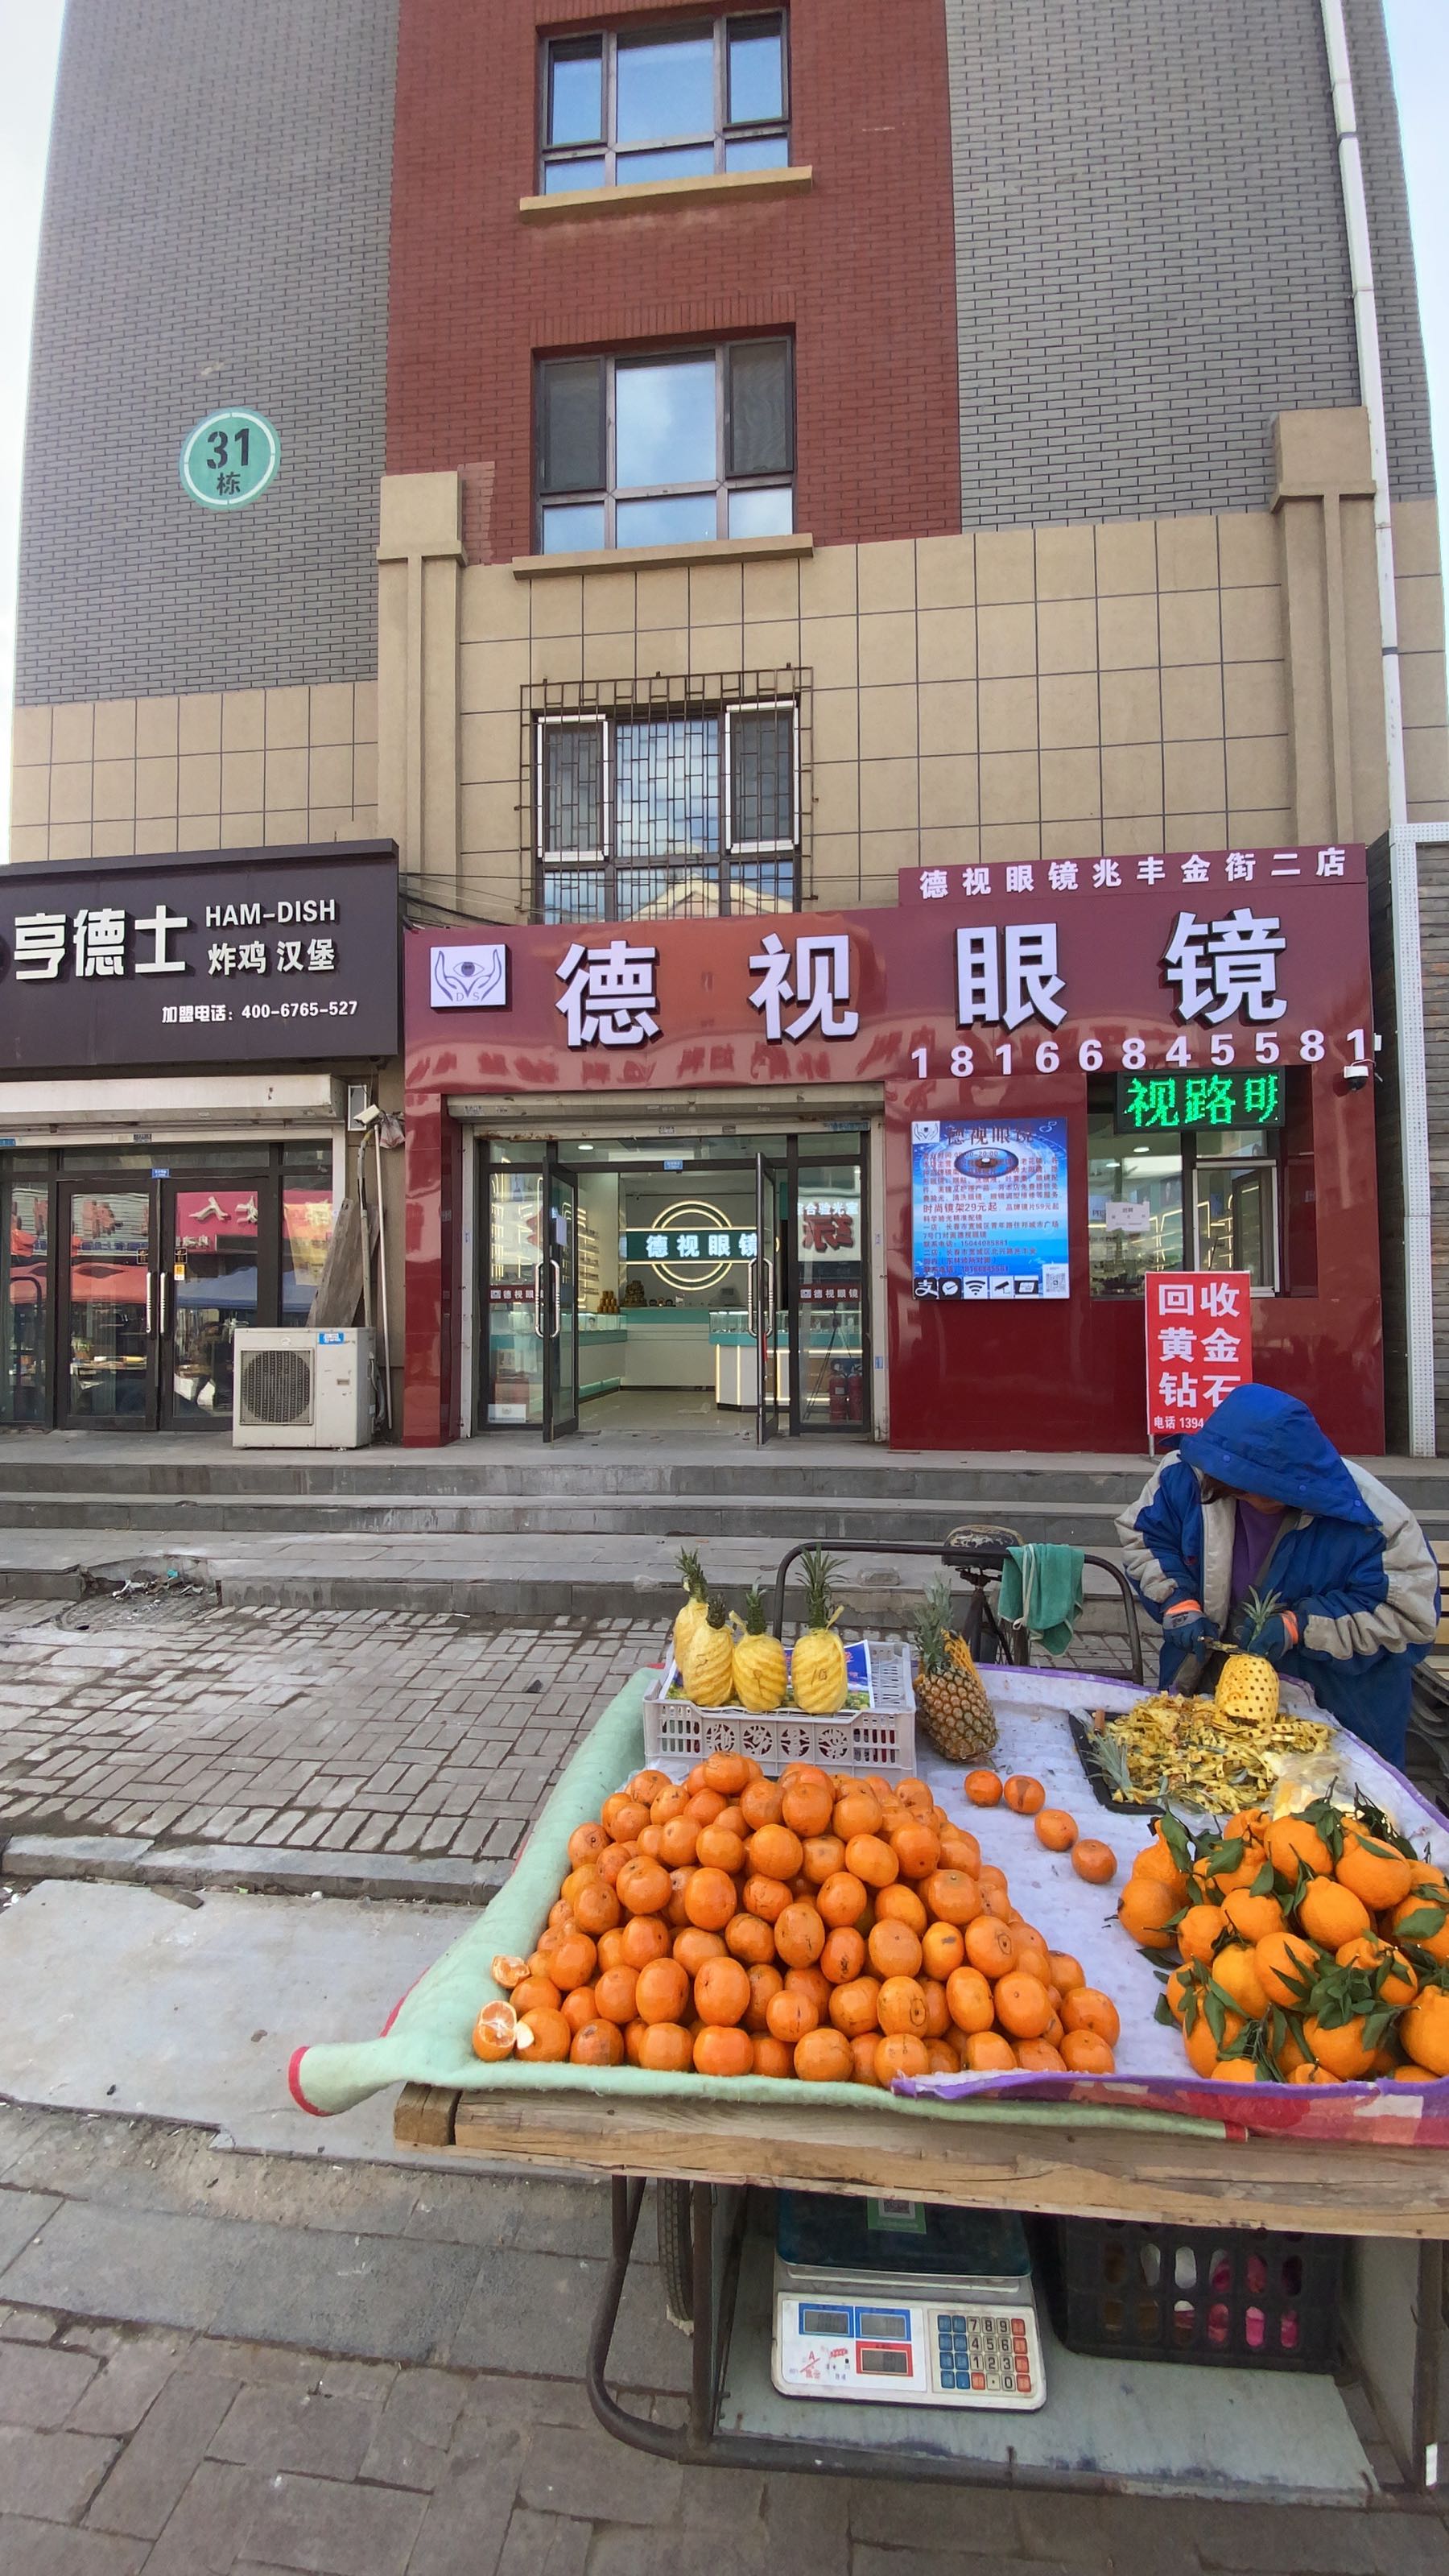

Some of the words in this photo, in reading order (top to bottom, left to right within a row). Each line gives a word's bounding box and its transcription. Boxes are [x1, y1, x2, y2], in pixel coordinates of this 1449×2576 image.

[207, 428, 250, 469] 31
[217, 472, 241, 496] 栋
[919, 847, 1346, 899] 德视眼镜兆丰金街二店
[205, 899, 336, 927] HAM-DISH
[208, 942, 266, 976] 炸鸡
[276, 939, 335, 972] 汉堡
[555, 907, 1288, 1046] 德视眼镜
[911, 1028, 1365, 1079] 18166845581
[646, 1233, 757, 1257] 德视眼镜
[1158, 1282, 1241, 1318] 回收
[1158, 1327, 1241, 1363] 黄金
[1158, 1372, 1241, 1408] 钻石
[1154, 1415, 1175, 1430] 电话
[970, 2319, 977, 2331] 7
[985, 2320, 993, 2332] 8
[1000, 2320, 1007, 2333] 9
[972, 2338, 979, 2350] 4
[987, 2339, 994, 2351] 5
[1001, 2339, 1009, 2351] 6
[988, 2357, 996, 2369] 2
[1003, 2357, 1011, 2370] 3
[1005, 2376, 1013, 2388] 0
